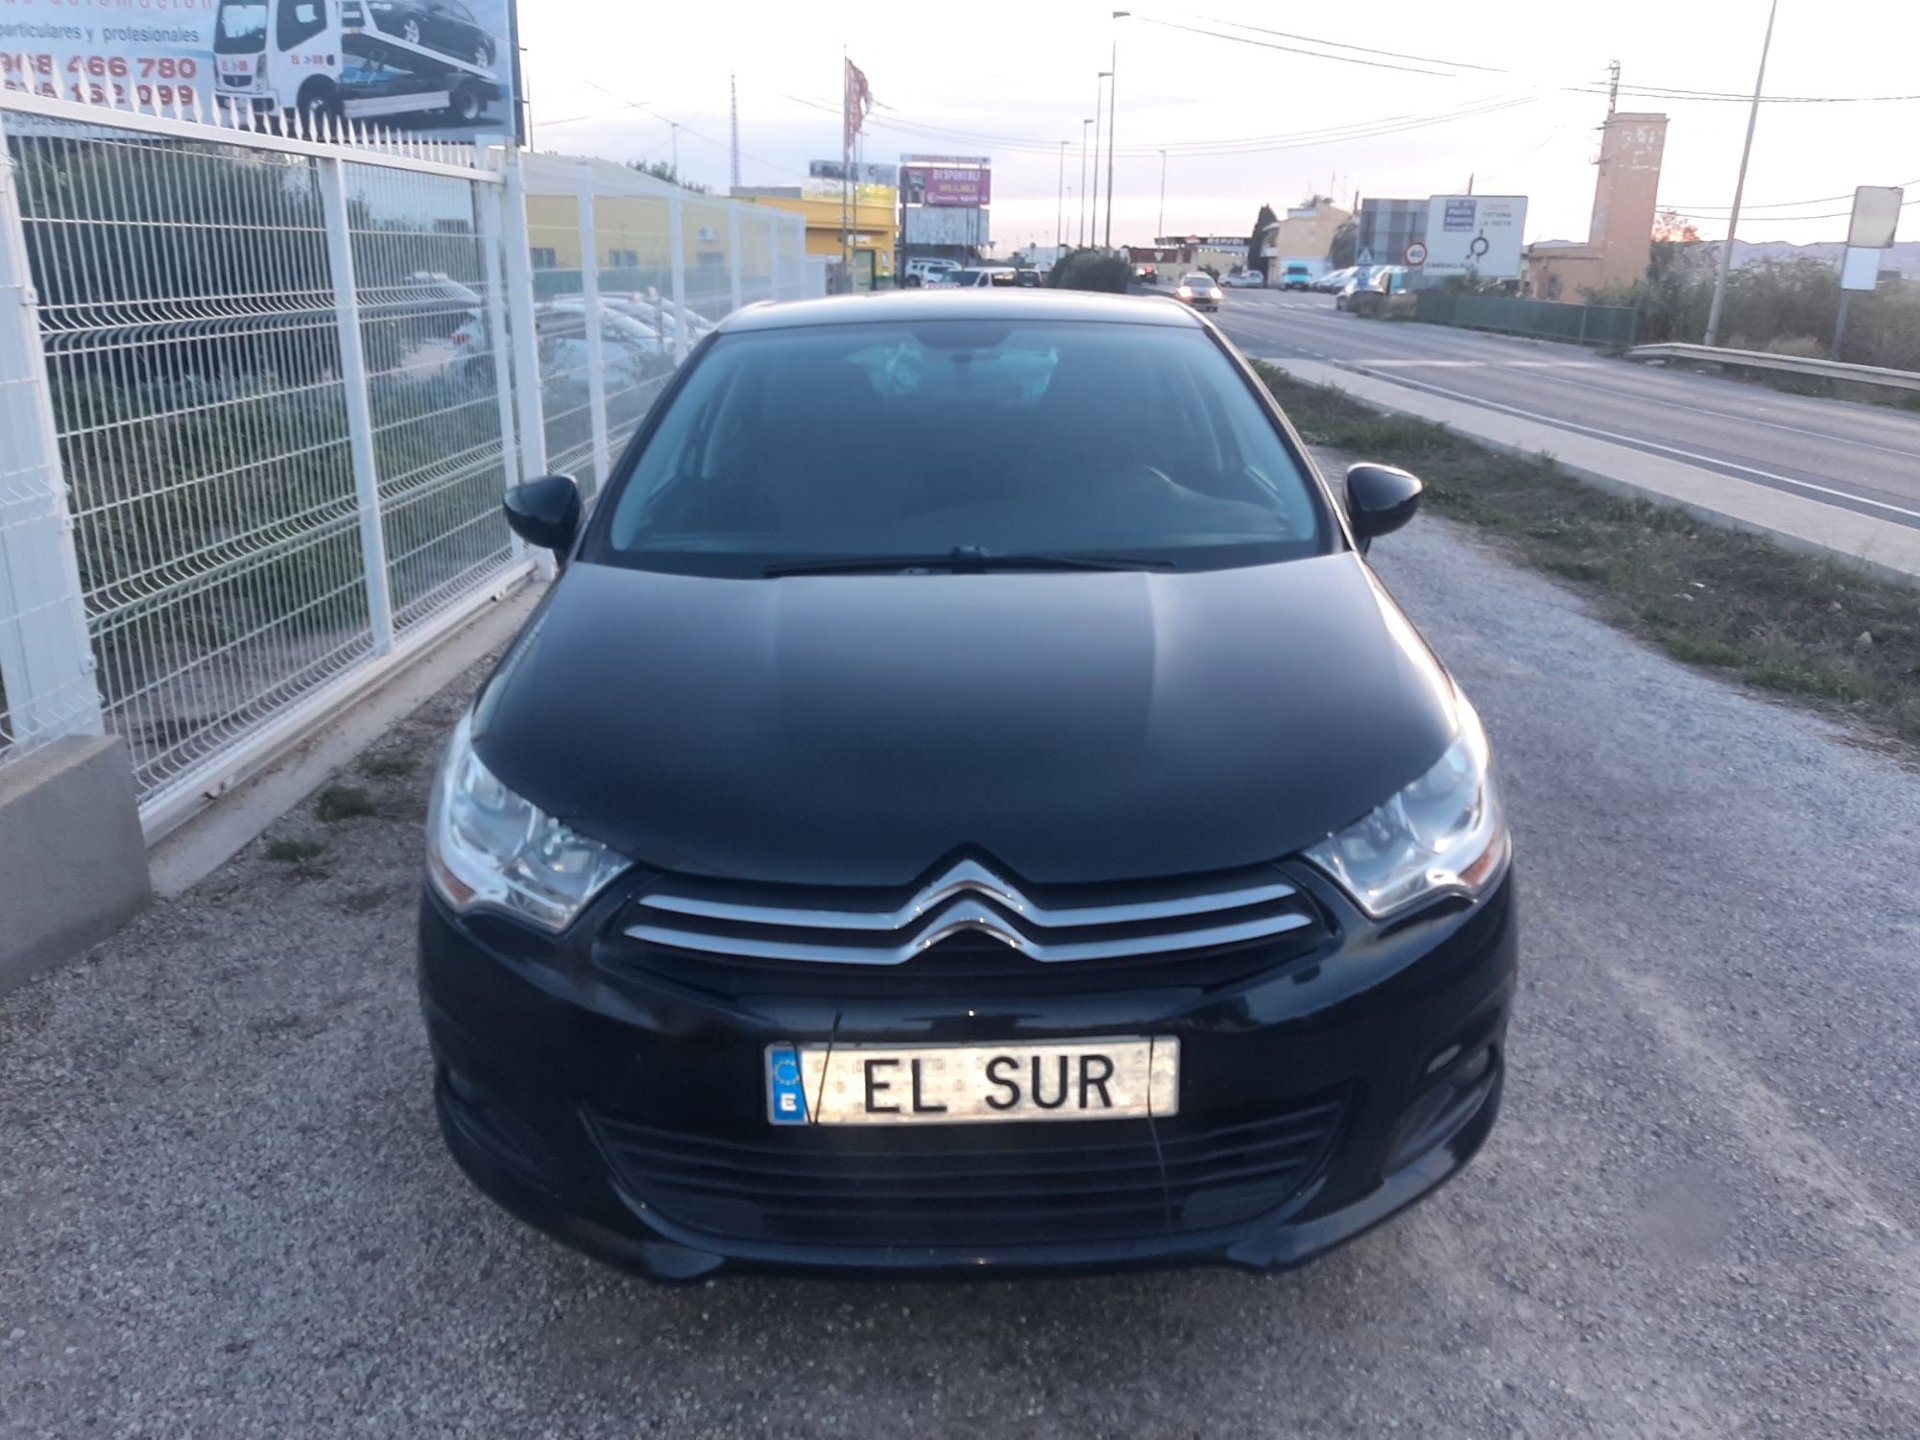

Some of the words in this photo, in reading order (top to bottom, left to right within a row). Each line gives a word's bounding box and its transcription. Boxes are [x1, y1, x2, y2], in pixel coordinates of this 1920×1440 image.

[85, 28, 95, 44] y
[102, 24, 200, 44] profesionales
[67, 54, 128, 78] 466
[136, 57, 197, 79] 780
[864, 1058, 948, 1114] EL
[985, 1054, 1114, 1110] SUR
[780, 1093, 797, 1112] E
